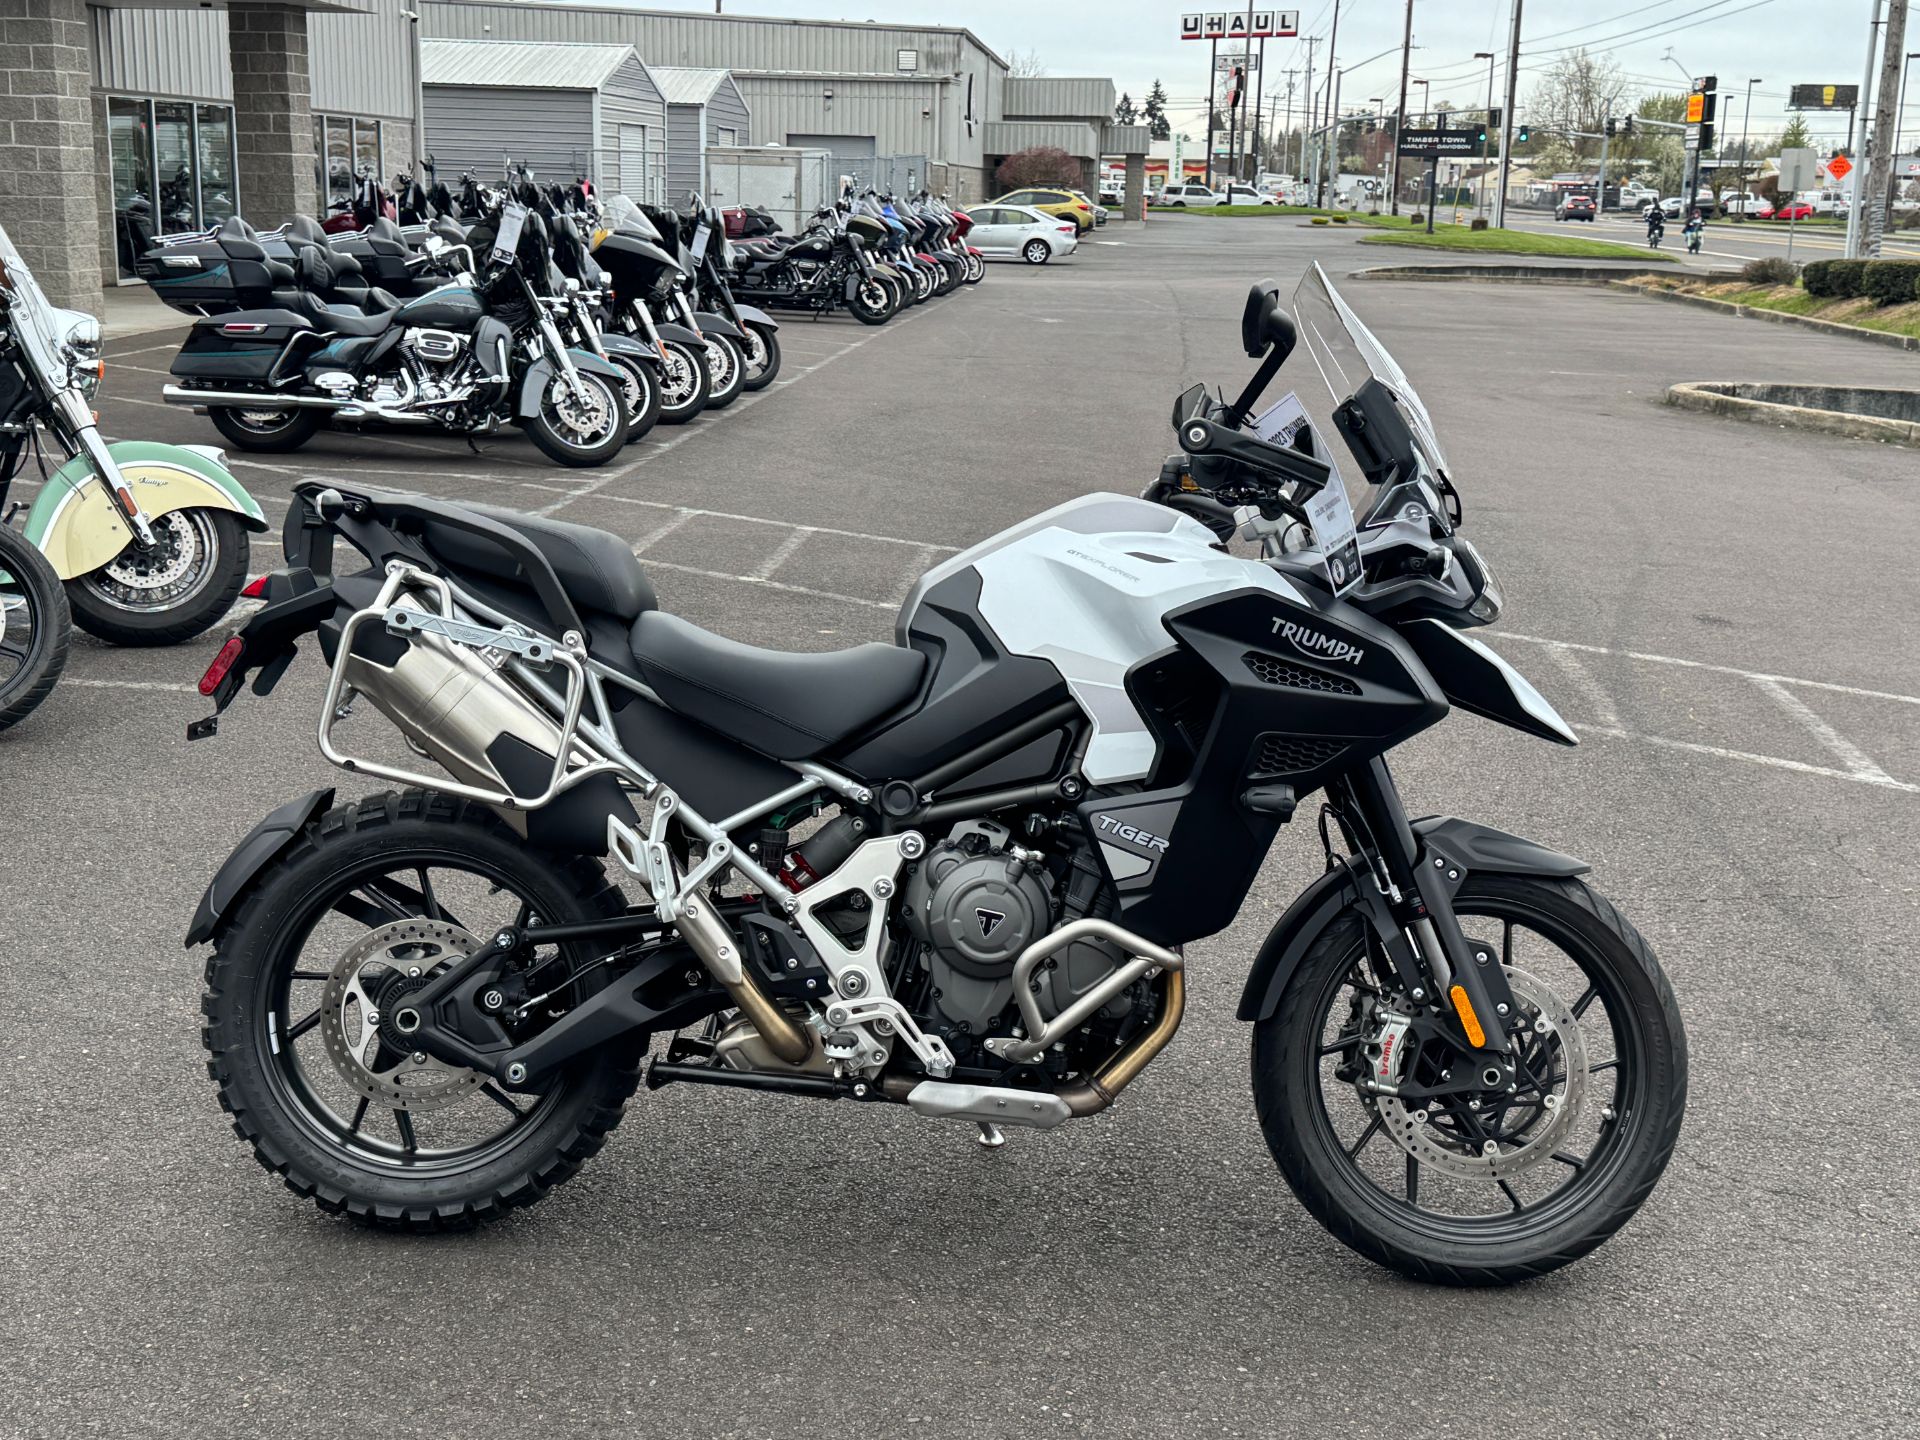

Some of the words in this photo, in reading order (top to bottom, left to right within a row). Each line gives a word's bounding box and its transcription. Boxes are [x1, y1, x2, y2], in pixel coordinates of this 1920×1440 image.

[1271, 616, 1365, 666] TRIUMPH
[1098, 814, 1170, 854] TIGER
[1380, 1033, 1396, 1076] brembo
